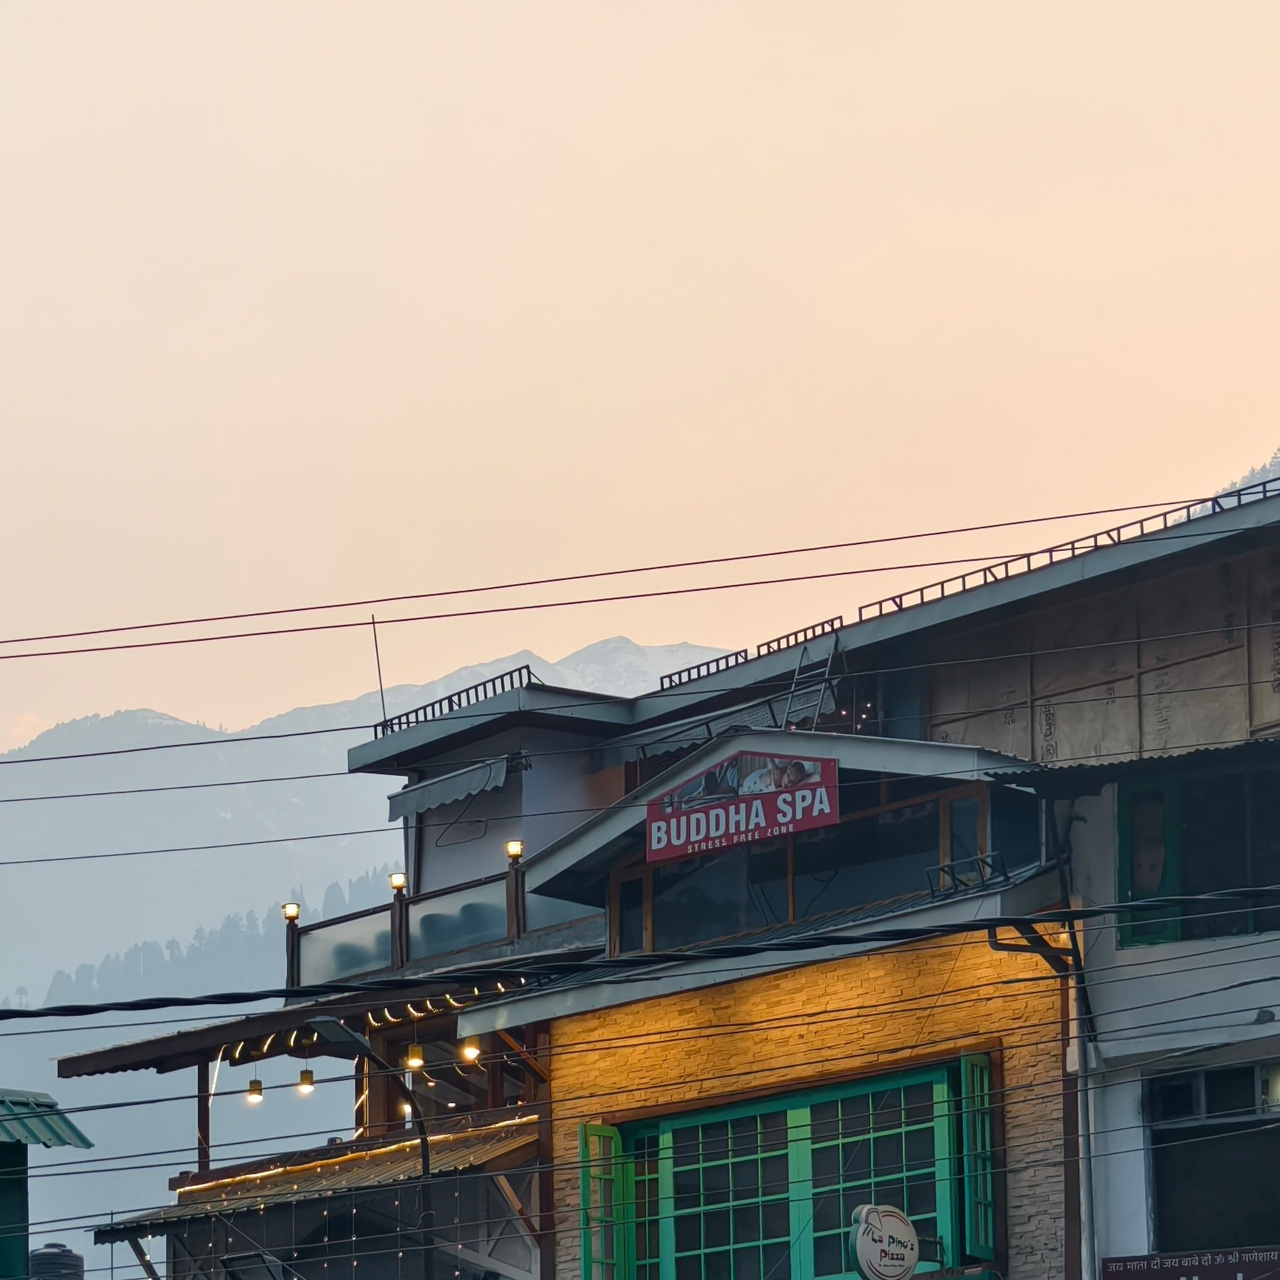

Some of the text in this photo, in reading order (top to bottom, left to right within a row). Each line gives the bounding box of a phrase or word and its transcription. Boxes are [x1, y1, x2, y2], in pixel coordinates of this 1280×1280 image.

[651, 787, 831, 850] BUDDHA SPA
[687, 837, 727, 853] STRESS
[733, 830, 760, 844] FREE
[871, 1231, 883, 1244] La
[880, 1249, 905, 1262] Pizza
